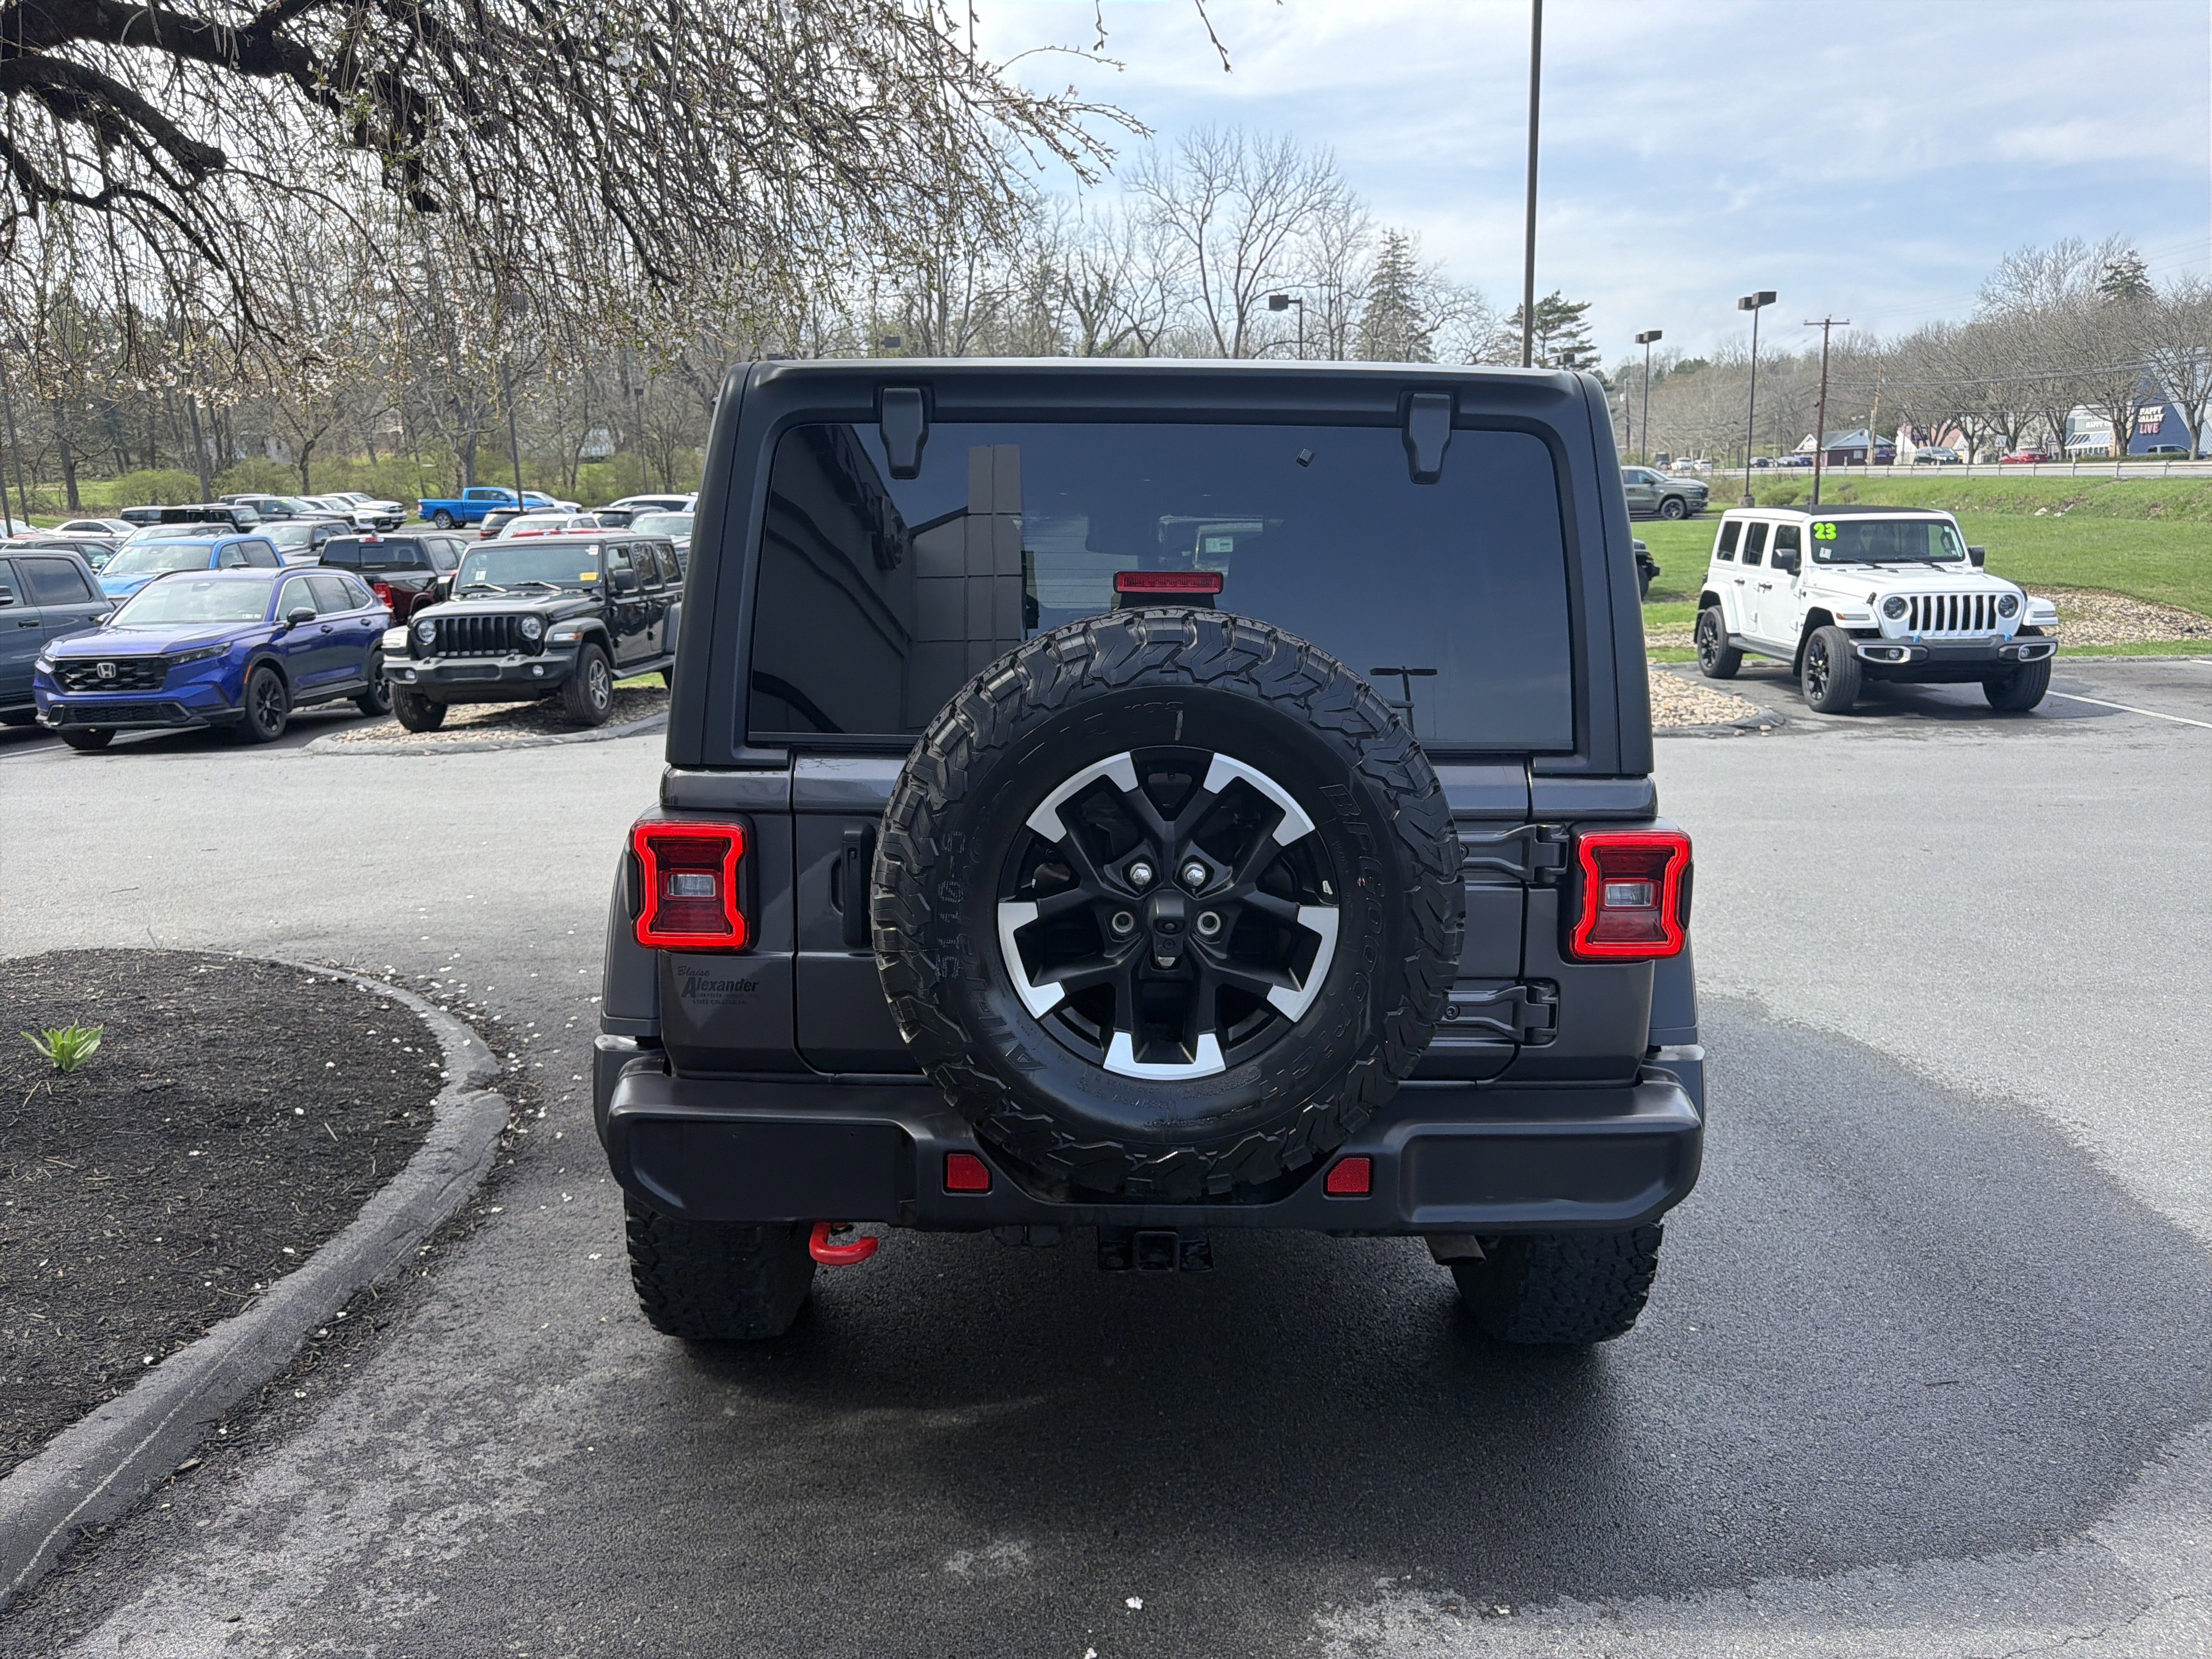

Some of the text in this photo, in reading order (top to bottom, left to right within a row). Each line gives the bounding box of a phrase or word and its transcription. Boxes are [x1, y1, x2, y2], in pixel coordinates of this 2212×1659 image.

[2139, 423, 2160, 435] LIVE
[1813, 522, 1837, 540] 23
[677, 965, 710, 977] Blaise
[681, 977, 759, 998] Alexander
